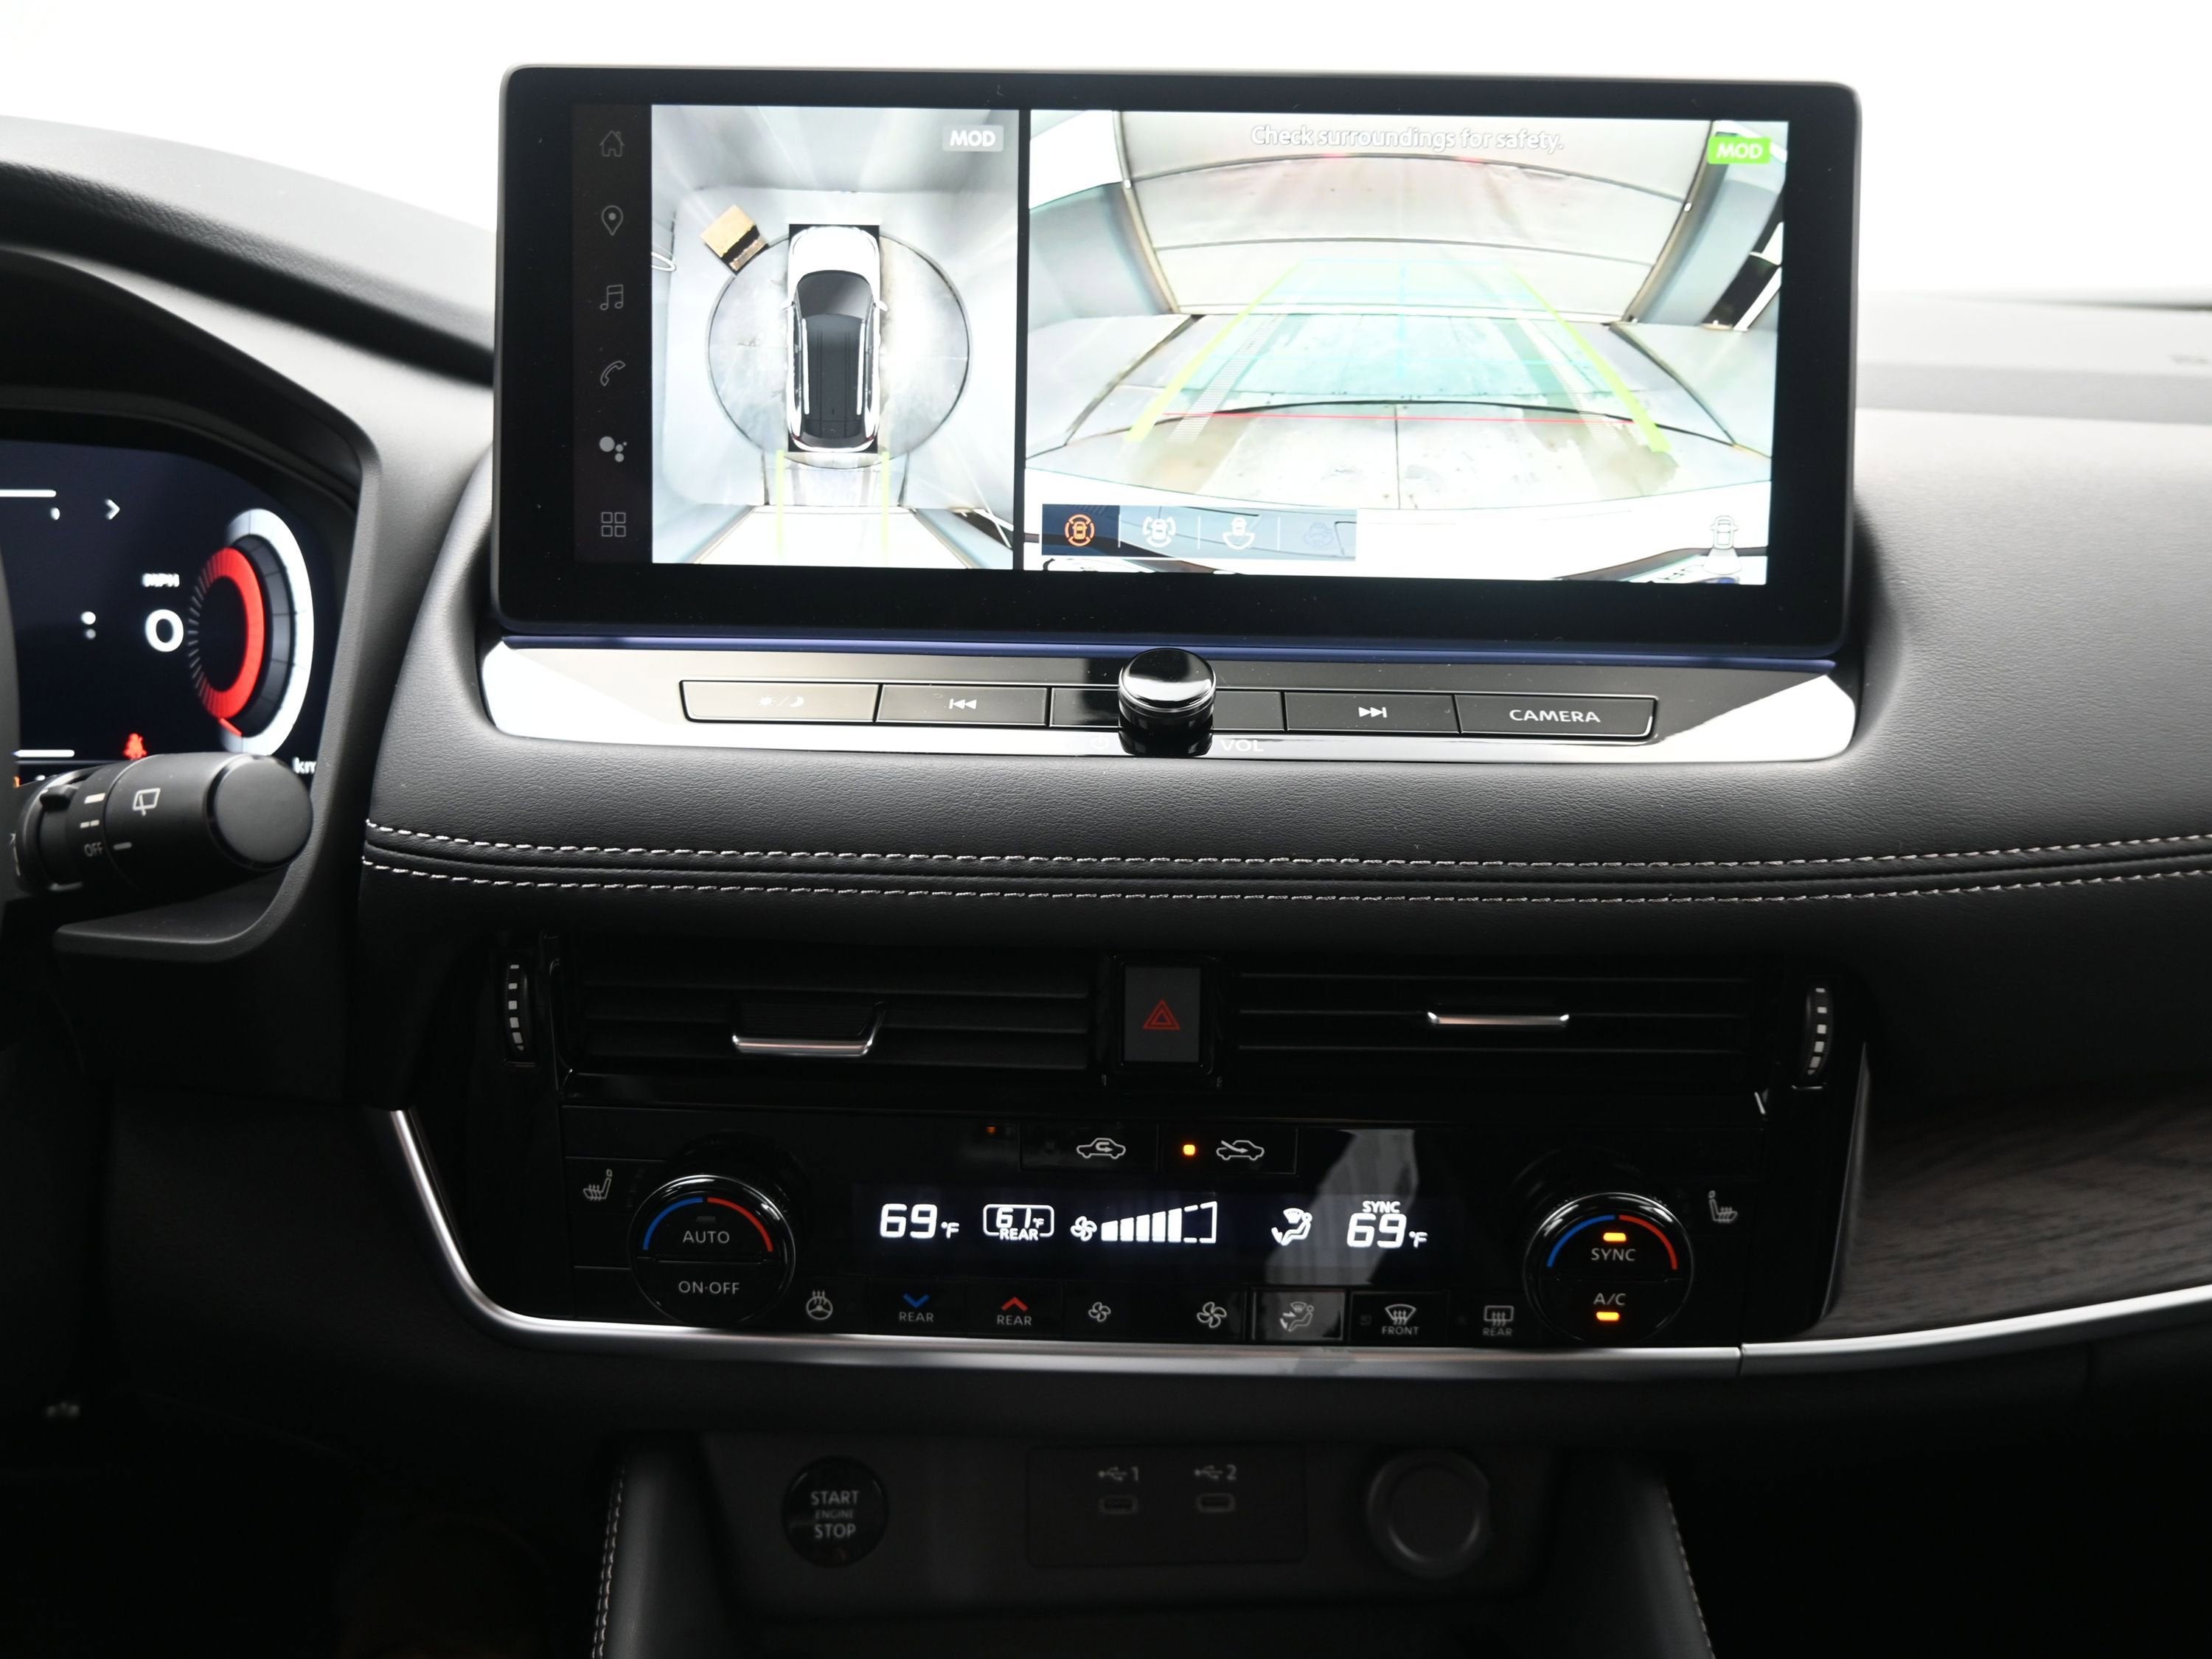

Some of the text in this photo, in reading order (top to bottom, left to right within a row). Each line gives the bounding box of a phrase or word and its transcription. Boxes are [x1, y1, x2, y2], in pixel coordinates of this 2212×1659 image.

[950, 130, 996, 147] MOD
[1251, 125, 1564, 153] Check surroundings for safety.
[1716, 142, 1764, 159] MOD
[1509, 709, 1601, 723] CAMERA
[1220, 739, 1264, 752] VOL
[84, 842, 103, 857] OFF
[1363, 1200, 1400, 1214] SYNC
[683, 1231, 730, 1244] AUTO
[999, 1228, 1039, 1241] REAR
[1591, 1248, 1636, 1262] SYNC
[1593, 1293, 1627, 1306] A/C
[899, 1312, 934, 1323] REAR
[997, 1315, 1032, 1326] REAR
[1382, 1326, 1419, 1336] FRONT
[1483, 1328, 1512, 1337] REAR
[810, 1490, 860, 1506] START
[814, 1523, 857, 1539] STOP
